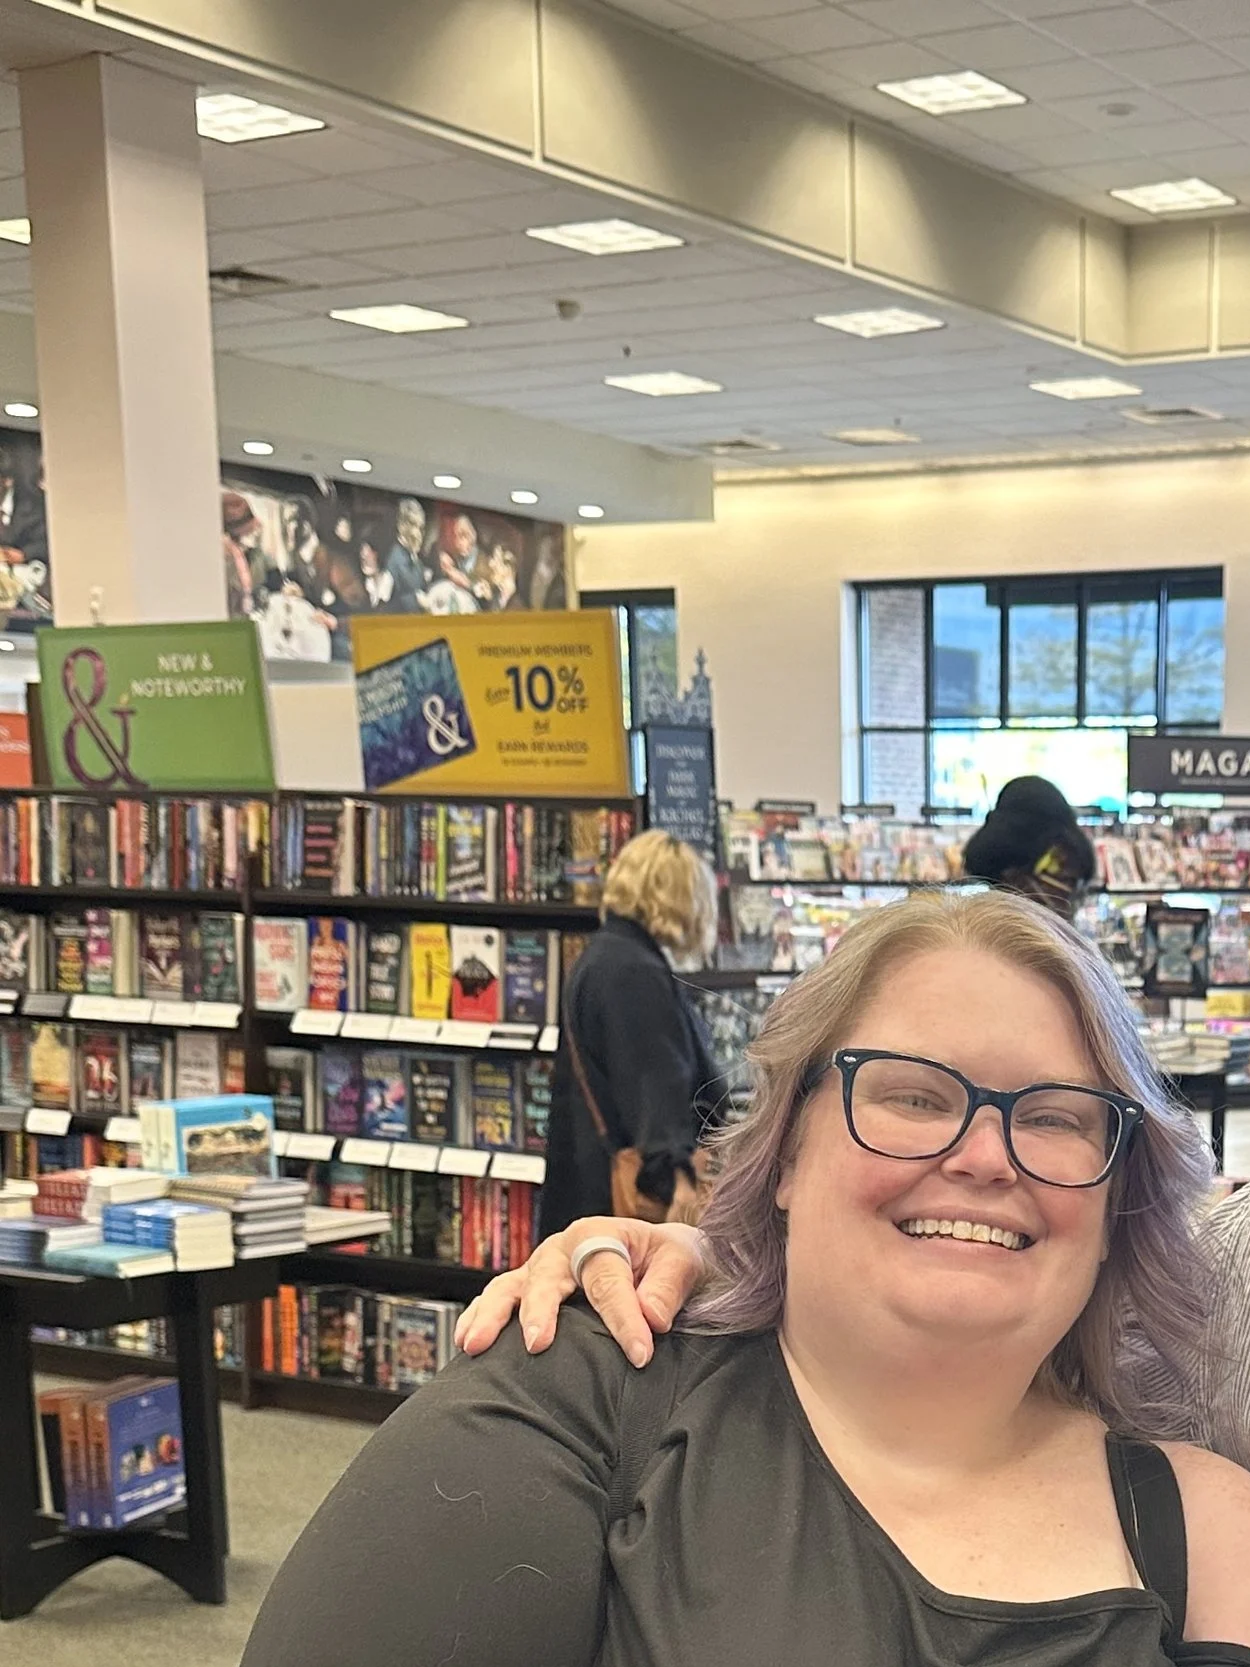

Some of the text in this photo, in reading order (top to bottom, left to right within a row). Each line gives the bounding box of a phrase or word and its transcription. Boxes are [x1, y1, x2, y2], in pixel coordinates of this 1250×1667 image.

[157, 652, 214, 673] NEW &
[130, 677, 247, 698] NOTEWORTHY
[557, 697, 589, 713] OFF
